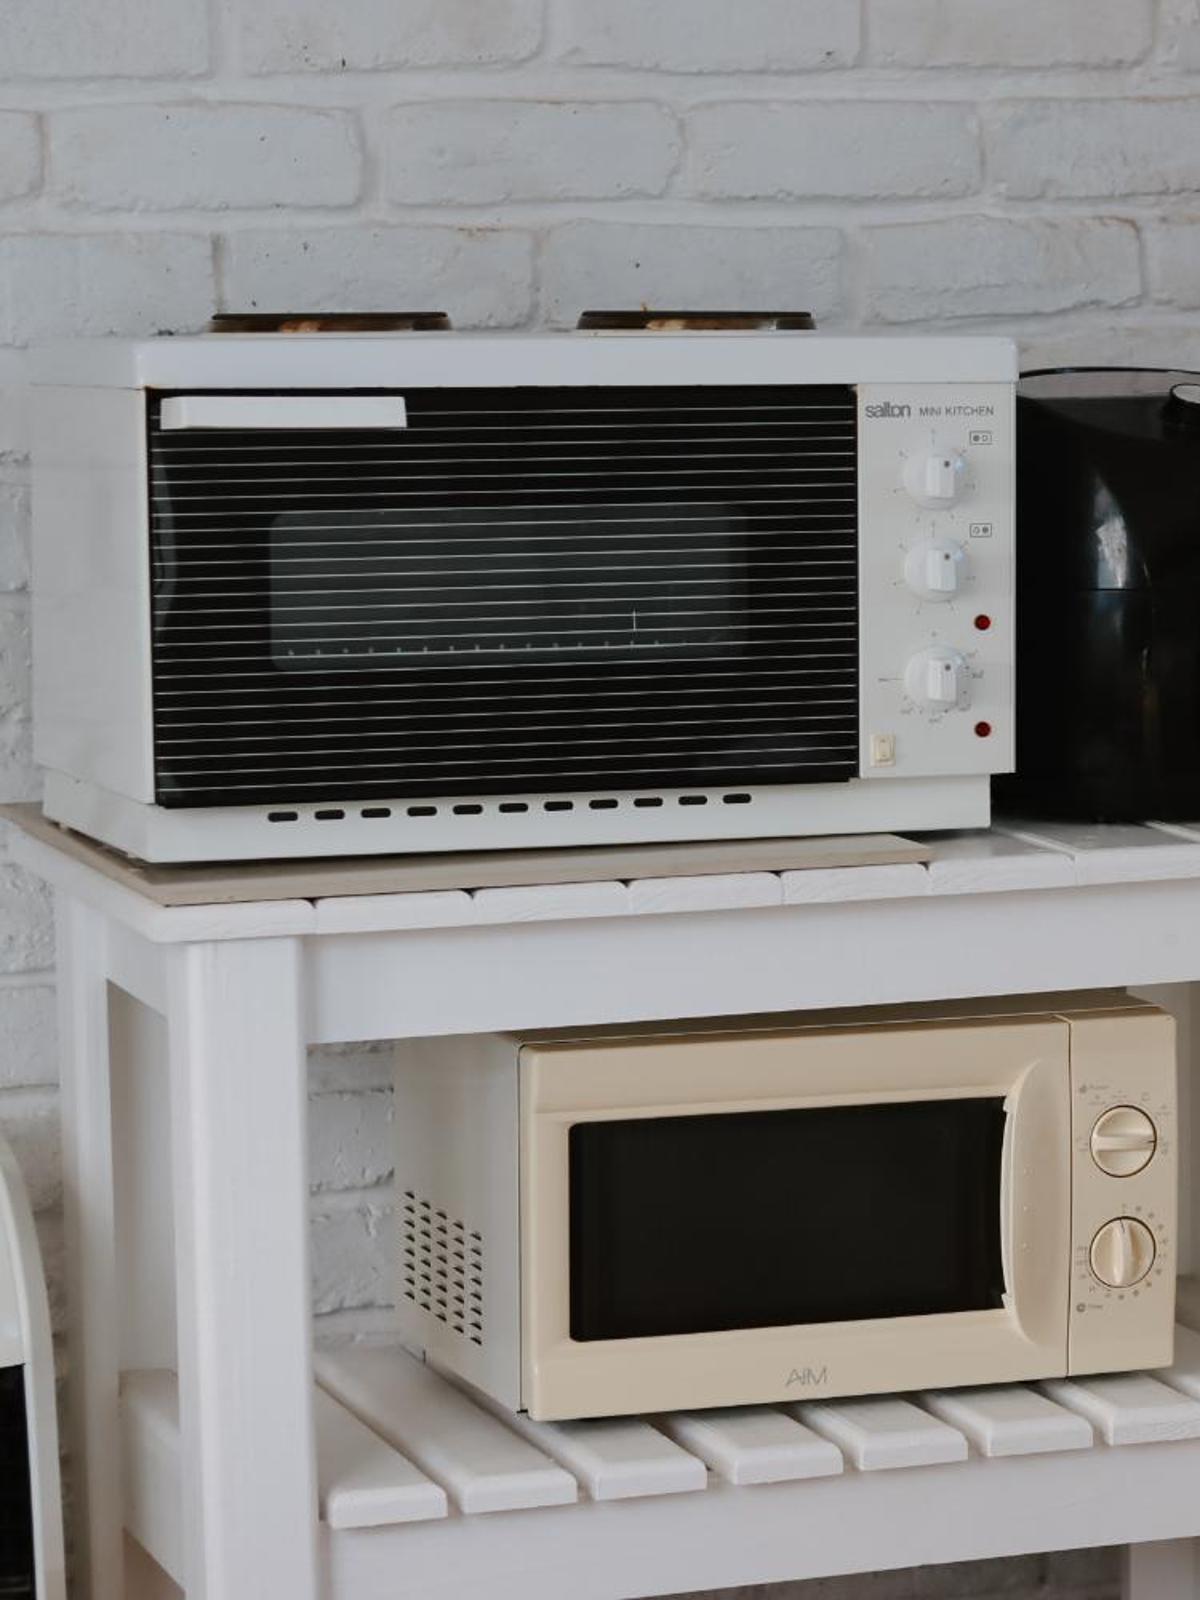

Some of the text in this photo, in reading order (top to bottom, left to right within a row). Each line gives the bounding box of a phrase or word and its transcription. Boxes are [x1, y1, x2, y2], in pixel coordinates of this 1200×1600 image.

[864, 401, 995, 419] salton MINI KITCHEN
[785, 1366, 828, 1387] AIM
